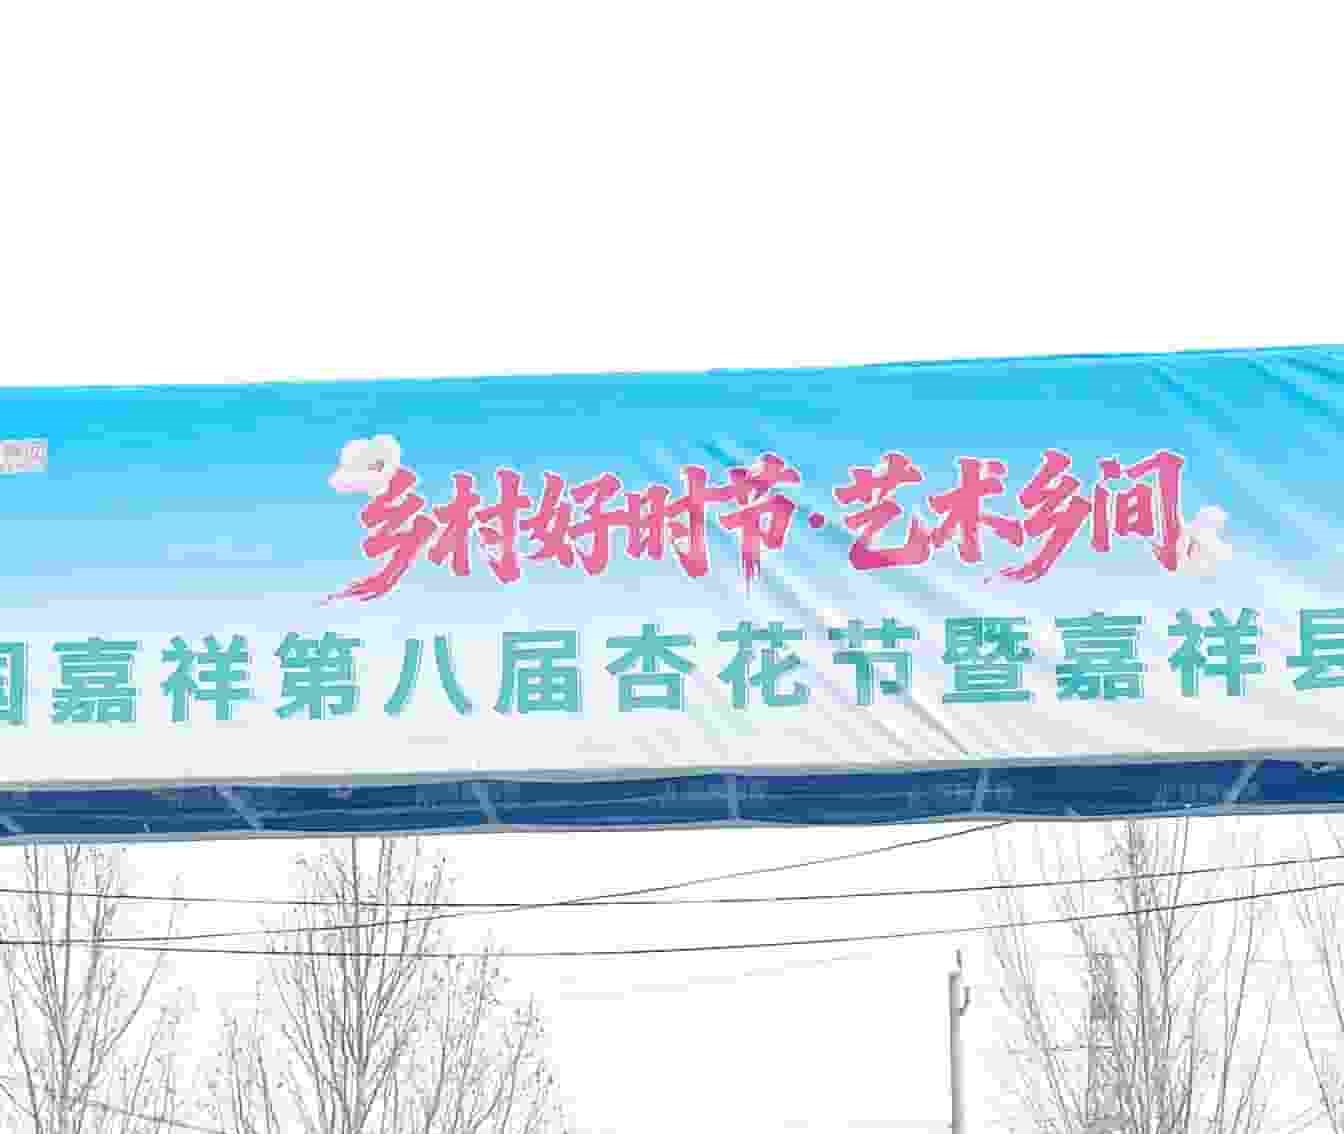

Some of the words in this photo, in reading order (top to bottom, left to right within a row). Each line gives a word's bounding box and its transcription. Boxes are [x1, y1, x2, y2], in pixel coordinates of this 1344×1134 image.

[320, 450, 1186, 604] 乡村好时节·艺术乡间
